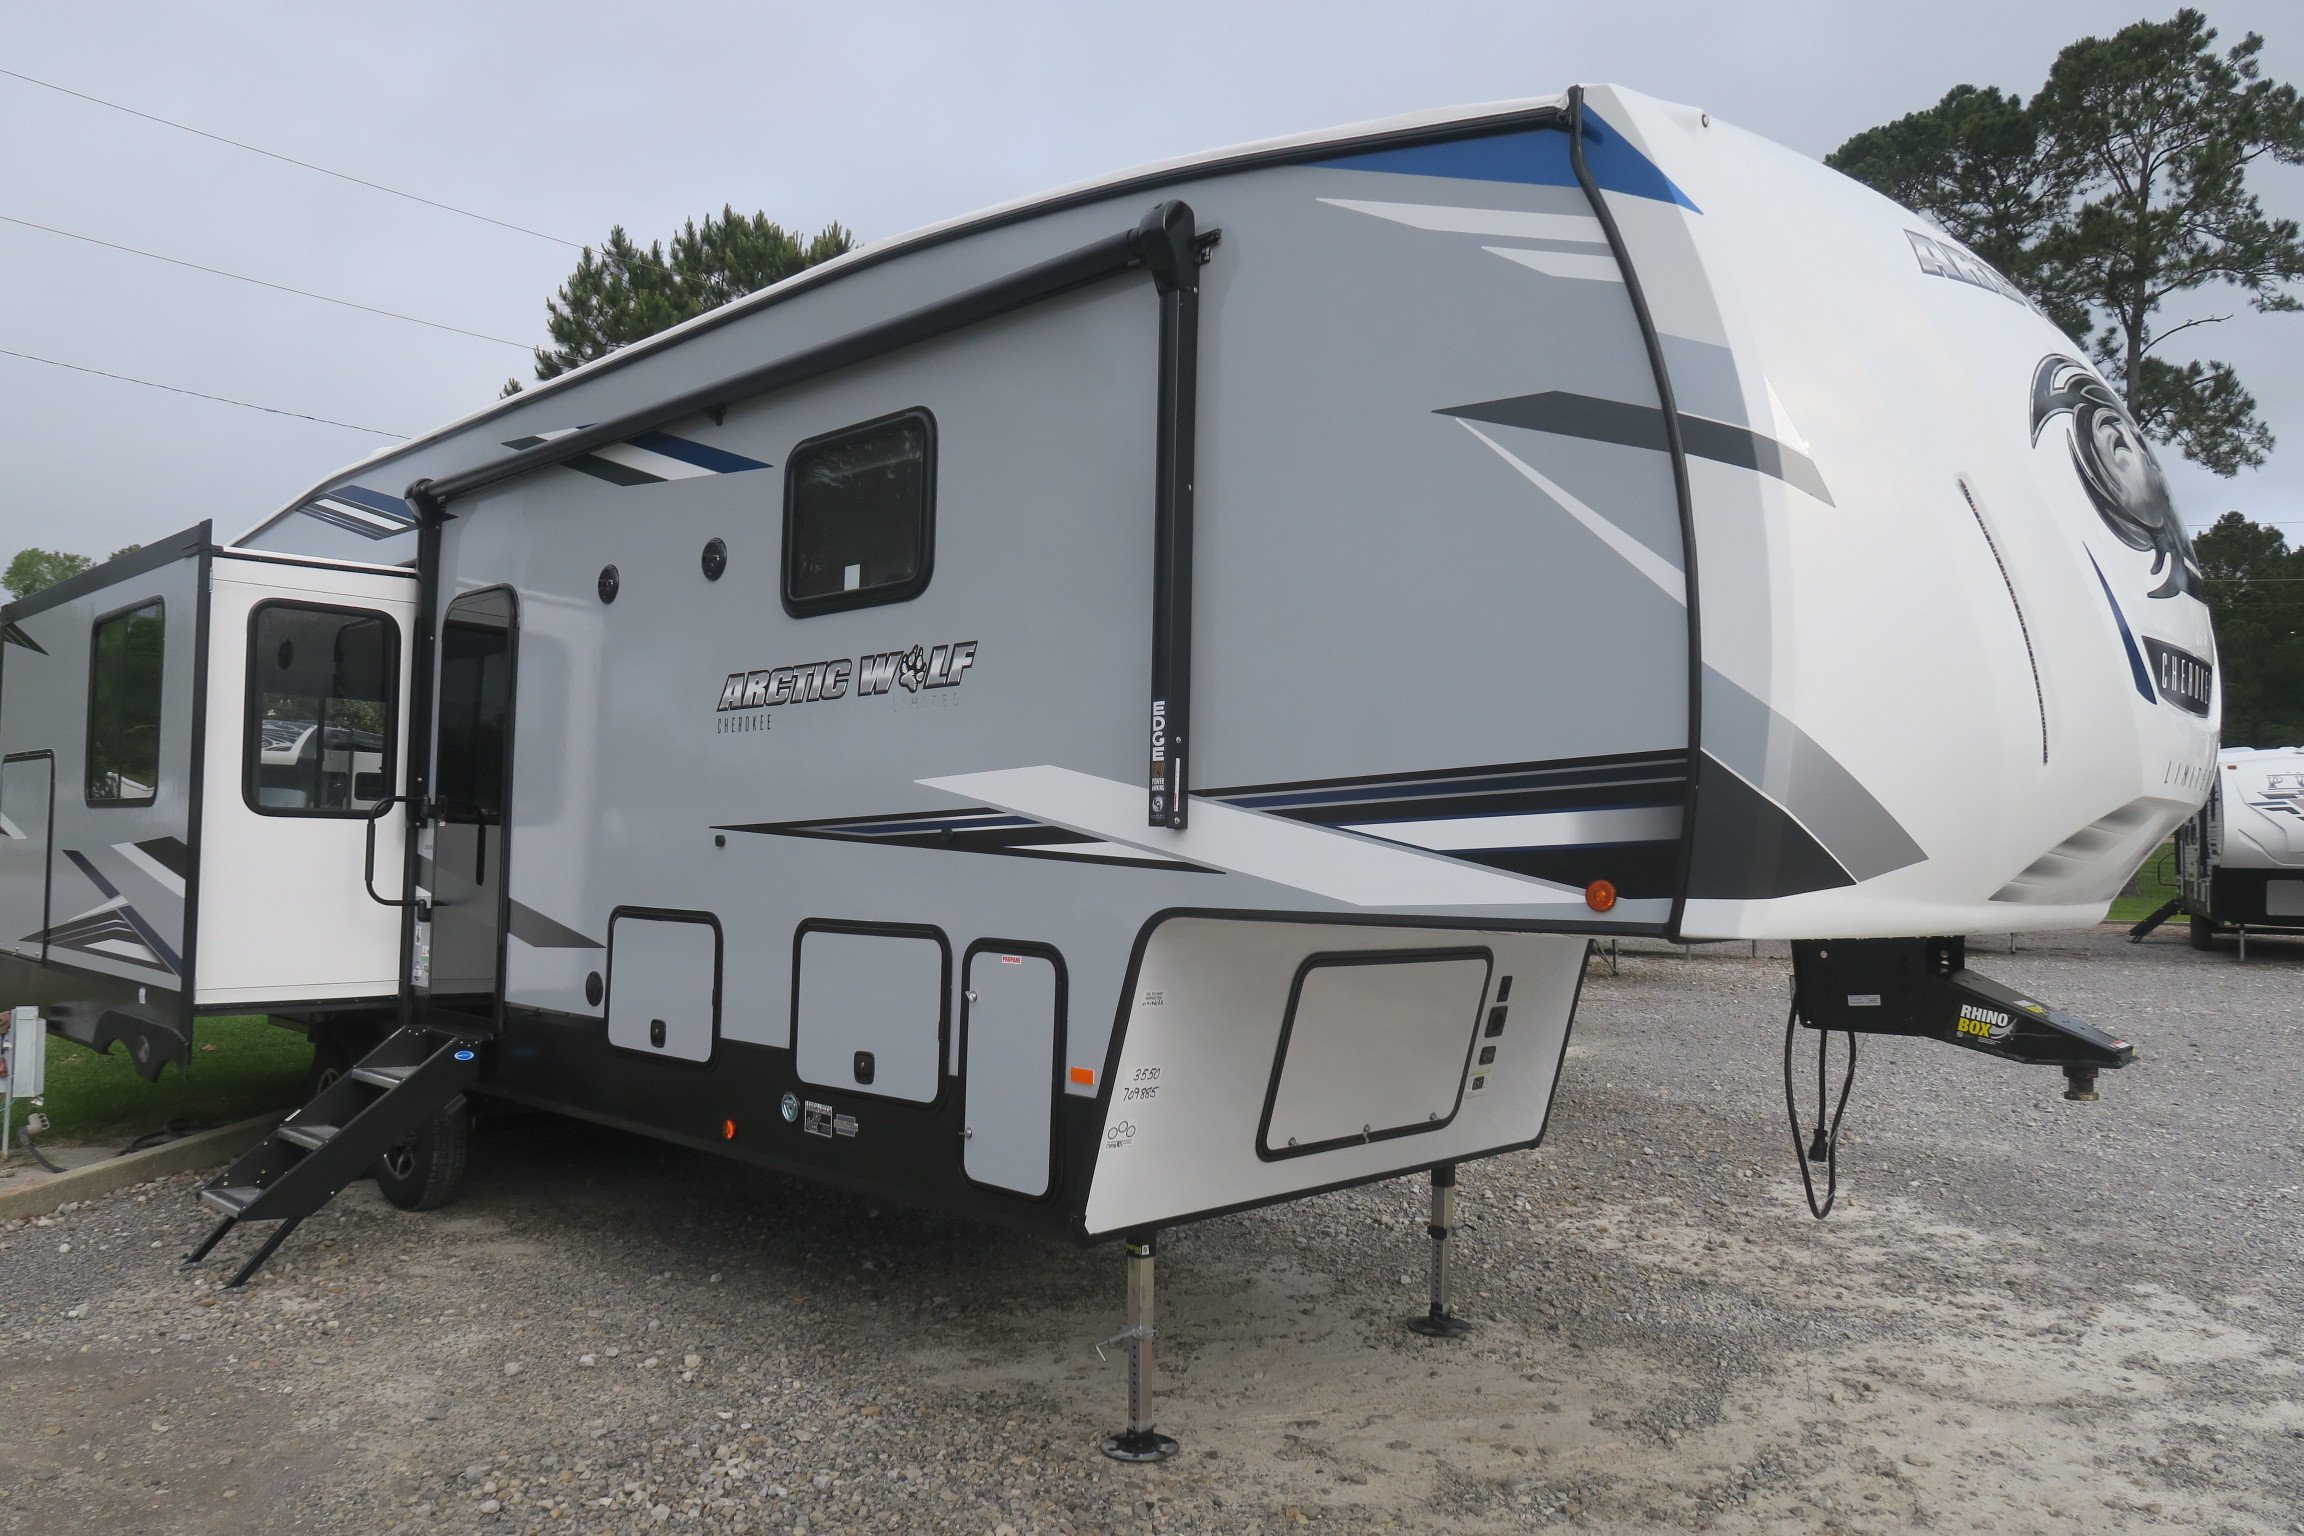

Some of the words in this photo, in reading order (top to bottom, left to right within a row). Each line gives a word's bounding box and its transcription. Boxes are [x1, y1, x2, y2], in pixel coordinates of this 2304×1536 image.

[716, 658, 853, 712] ARCTIC
[717, 714, 772, 734] CHEROKEE
[1152, 700, 1166, 762] EDGE
[1002, 956, 1021, 964] PROPANE
[1960, 1004, 2009, 1027] RHINO
[1957, 1017, 1992, 1038] BOX
[1133, 1067, 1161, 1081] 3550
[1122, 1086, 1160, 1102] 709885
